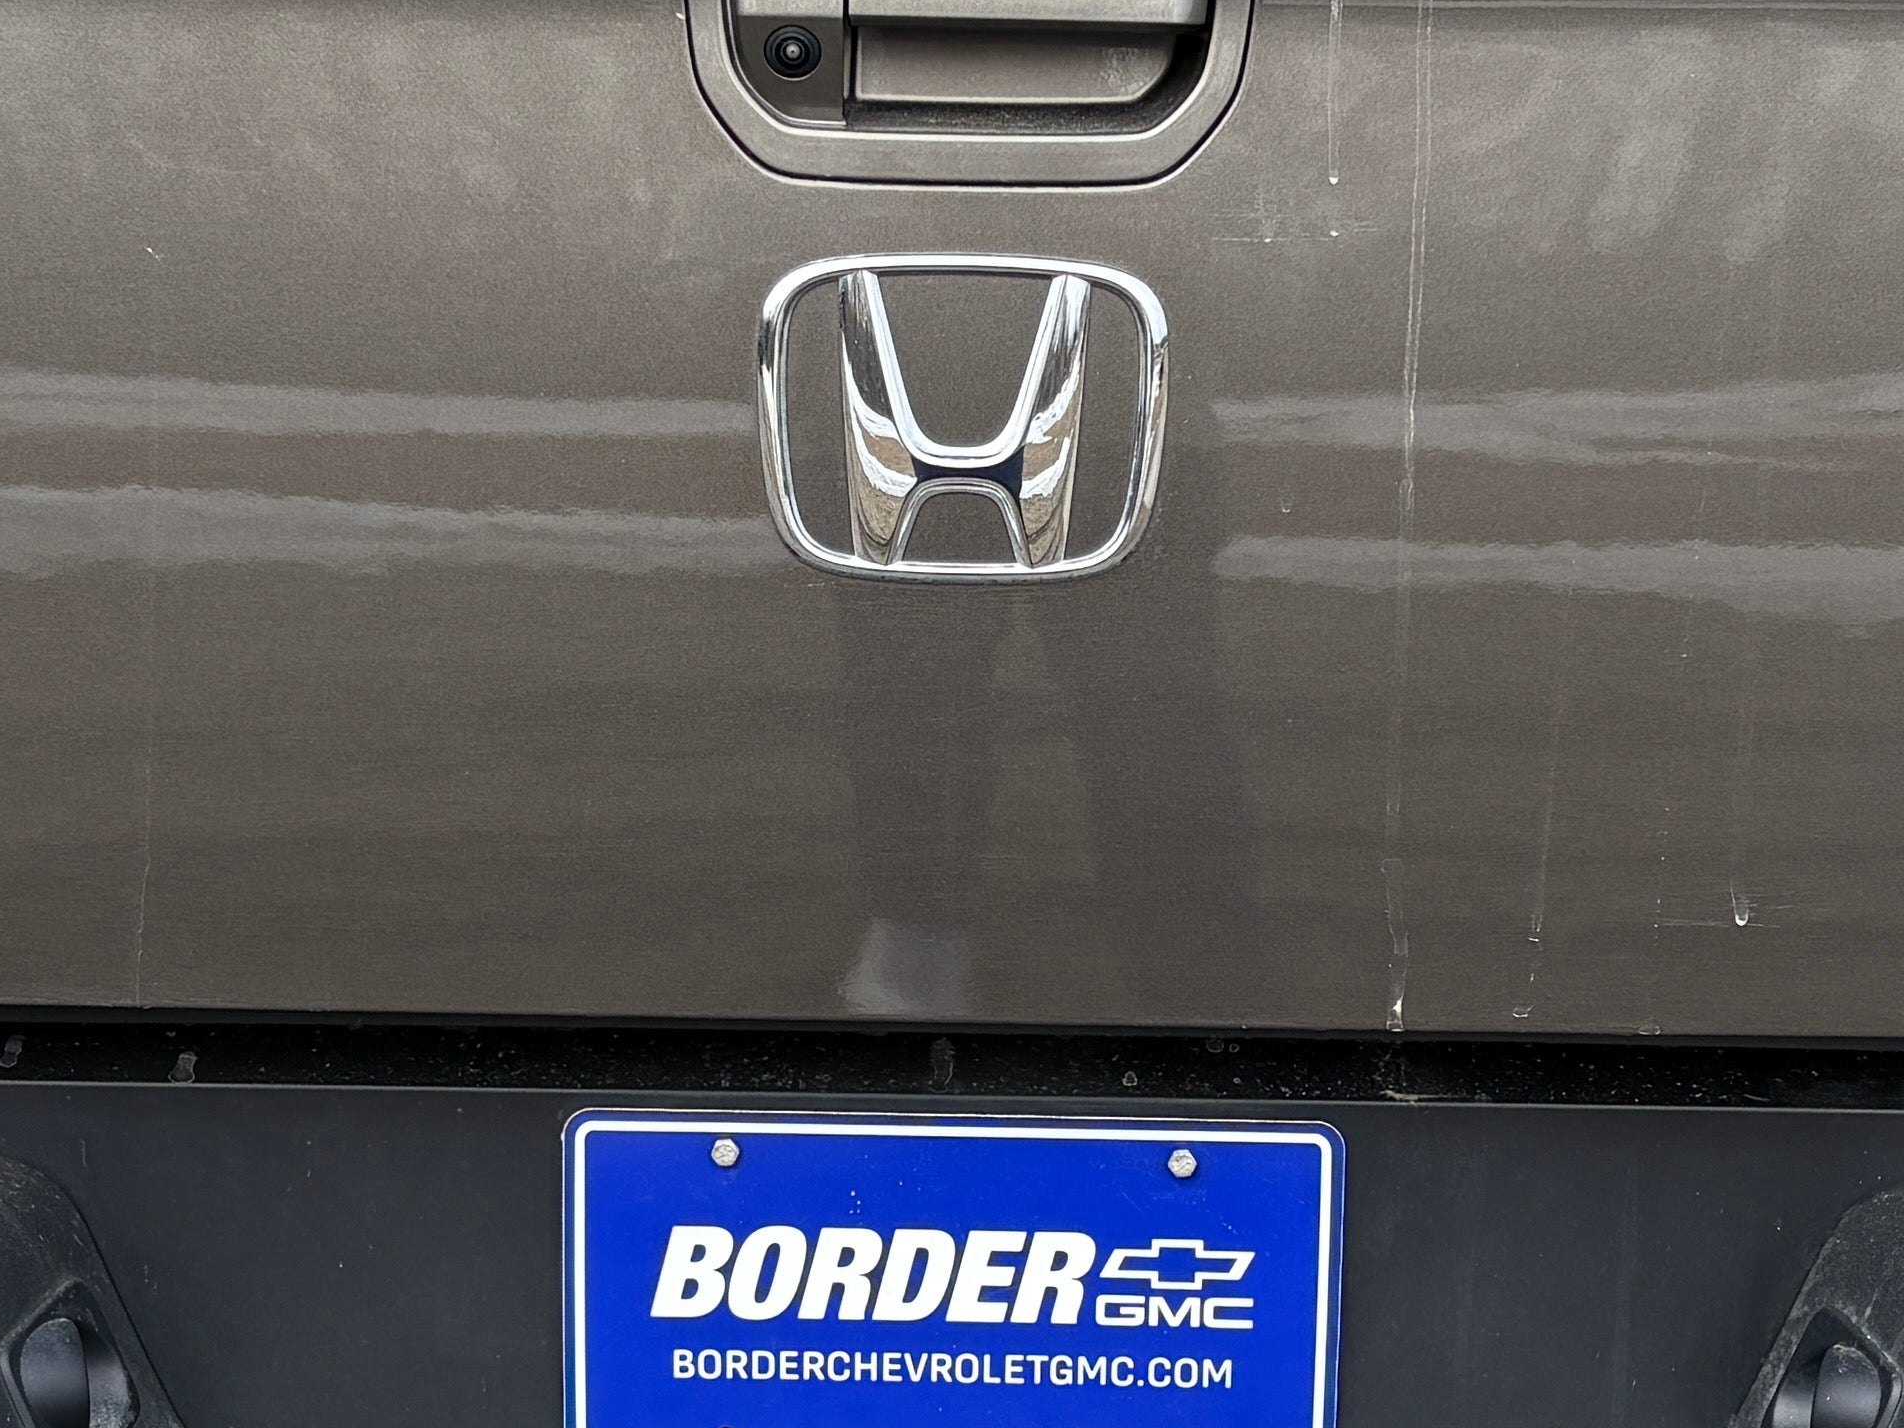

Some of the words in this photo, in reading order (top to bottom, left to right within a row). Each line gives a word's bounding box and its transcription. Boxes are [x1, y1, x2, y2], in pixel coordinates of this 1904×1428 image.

[649, 1224, 1097, 1326] BORDER
[1095, 1294, 1254, 1330] GMC
[672, 1348, 1233, 1390] BORDERCHEVROLETGMC.COM
